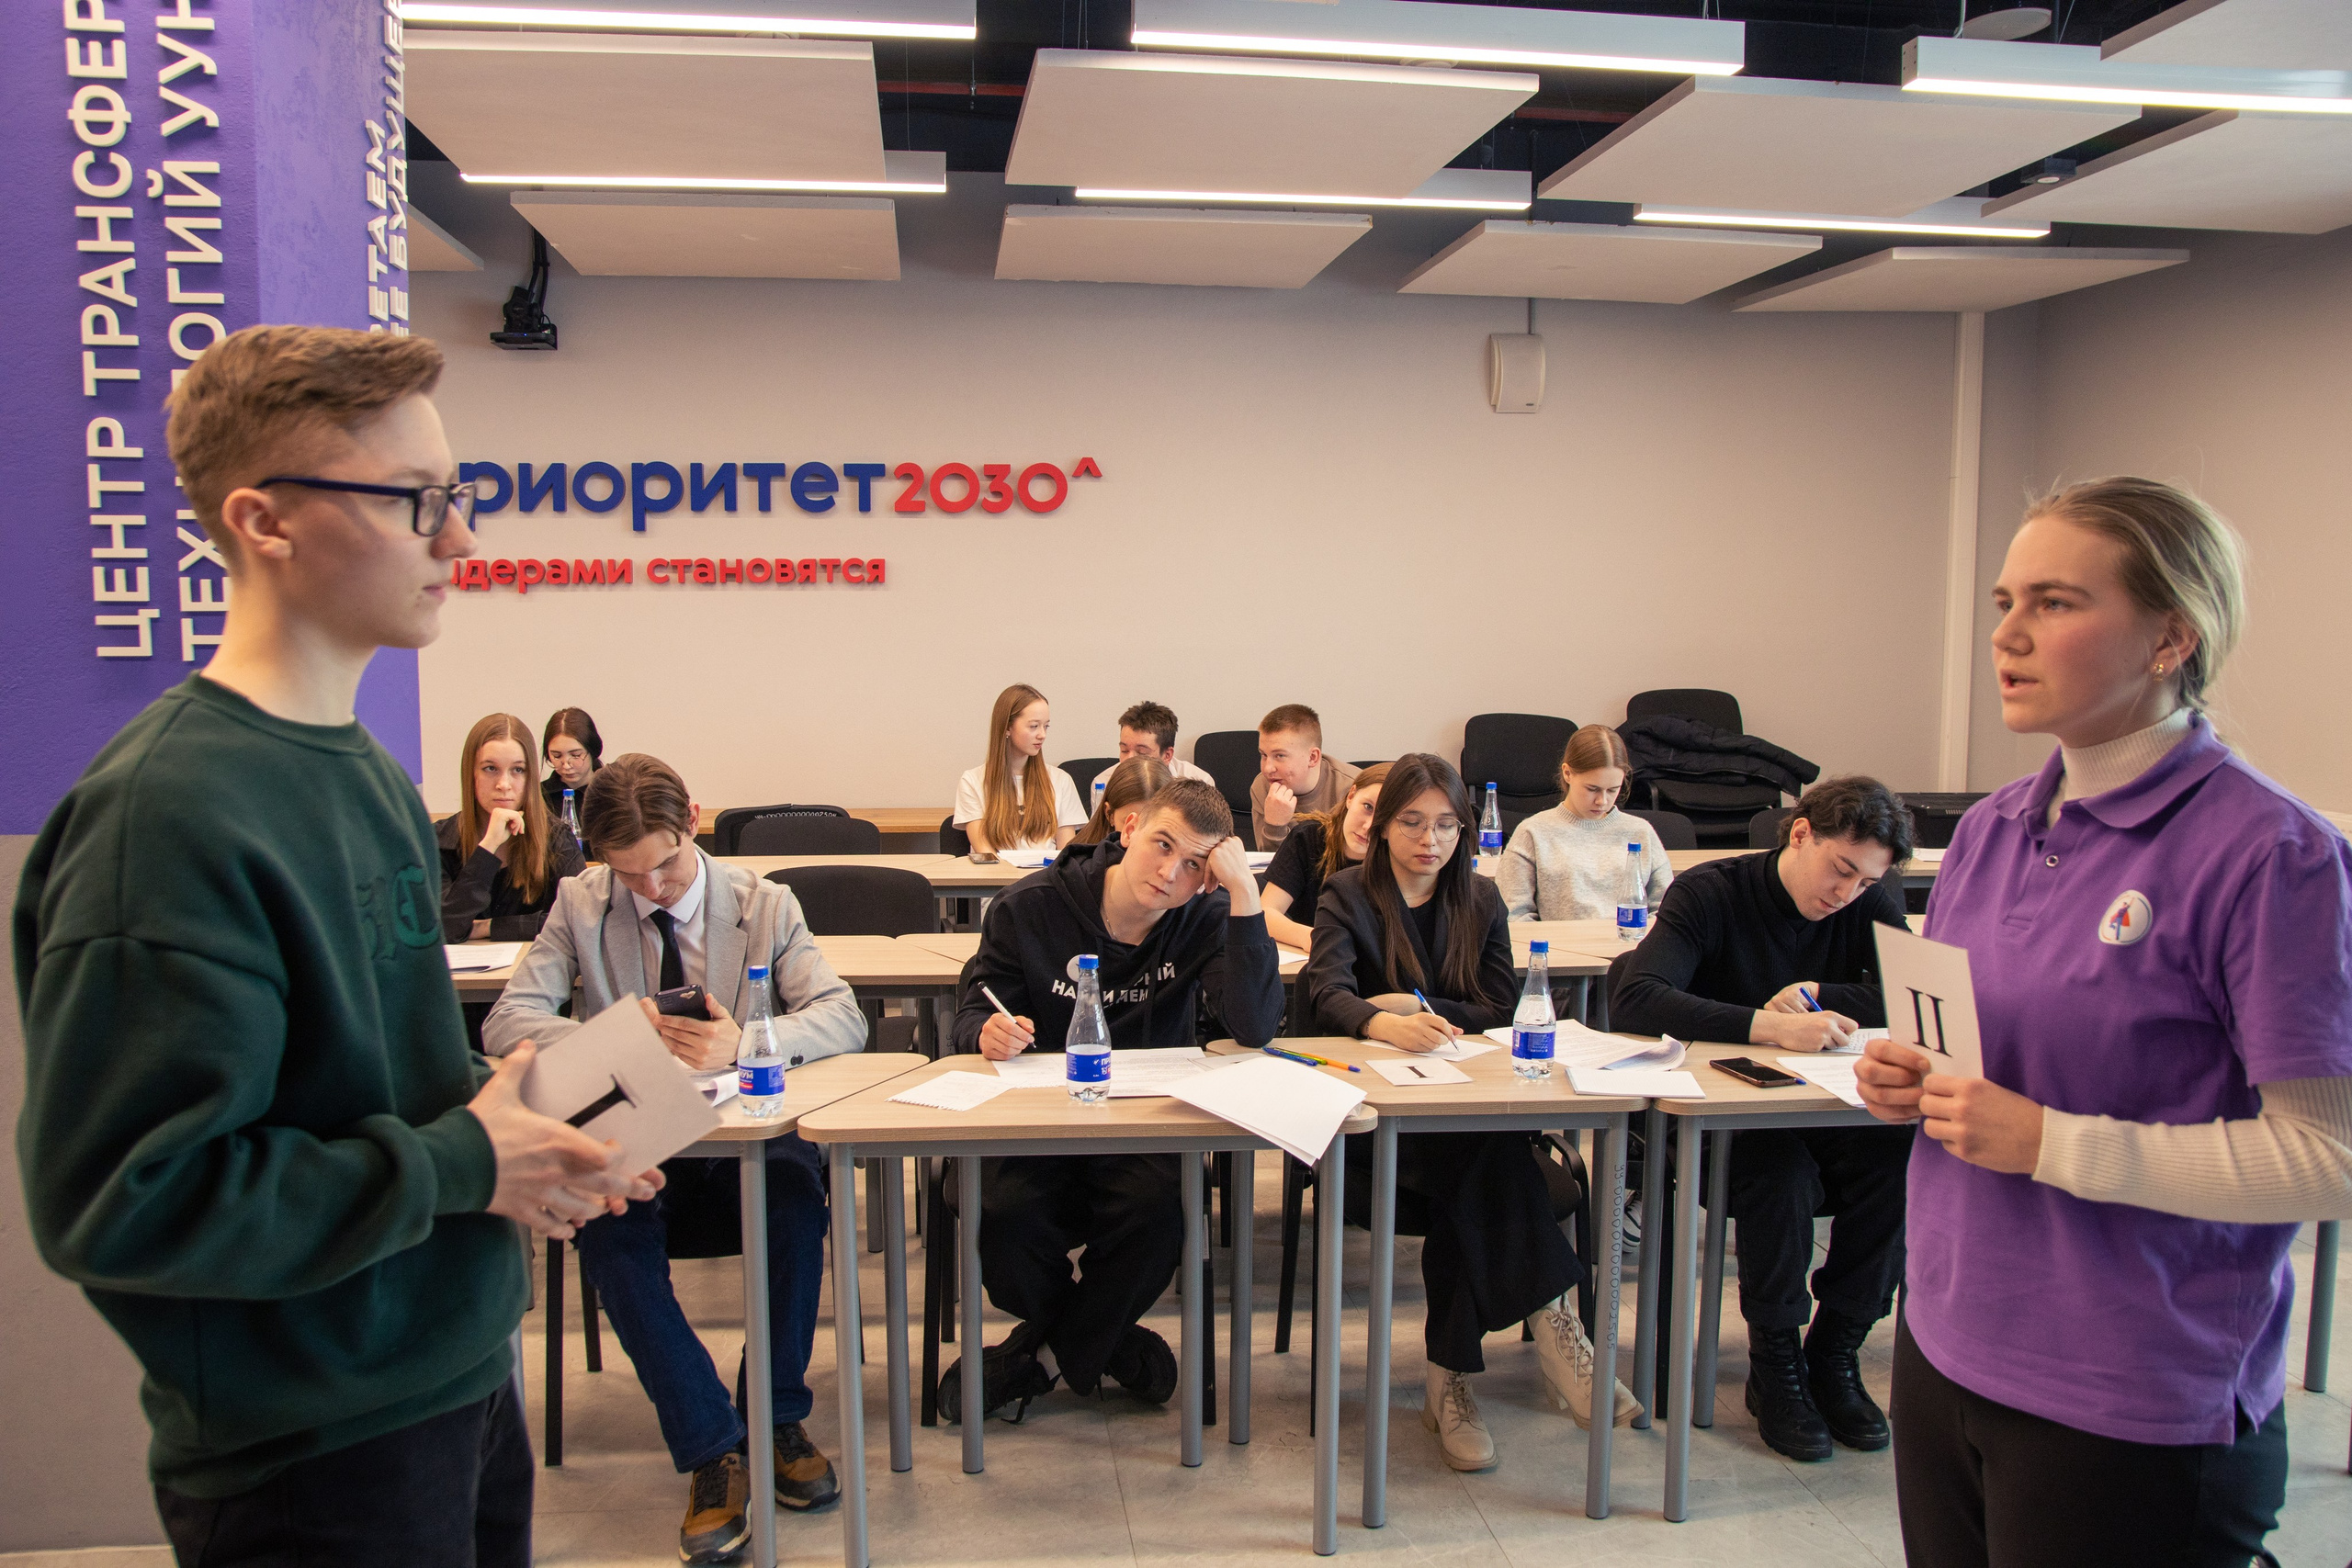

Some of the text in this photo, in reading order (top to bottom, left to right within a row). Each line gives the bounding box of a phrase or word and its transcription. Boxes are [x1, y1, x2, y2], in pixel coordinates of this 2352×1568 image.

[365, 118, 389, 333] ЕТАЕМ
[86, 416, 160, 659] ЦЕНТР
[450, 557, 886, 594] дерами становятся
[1905, 986, 1952, 1058] II
[1399, 1065, 1435, 1078] I
